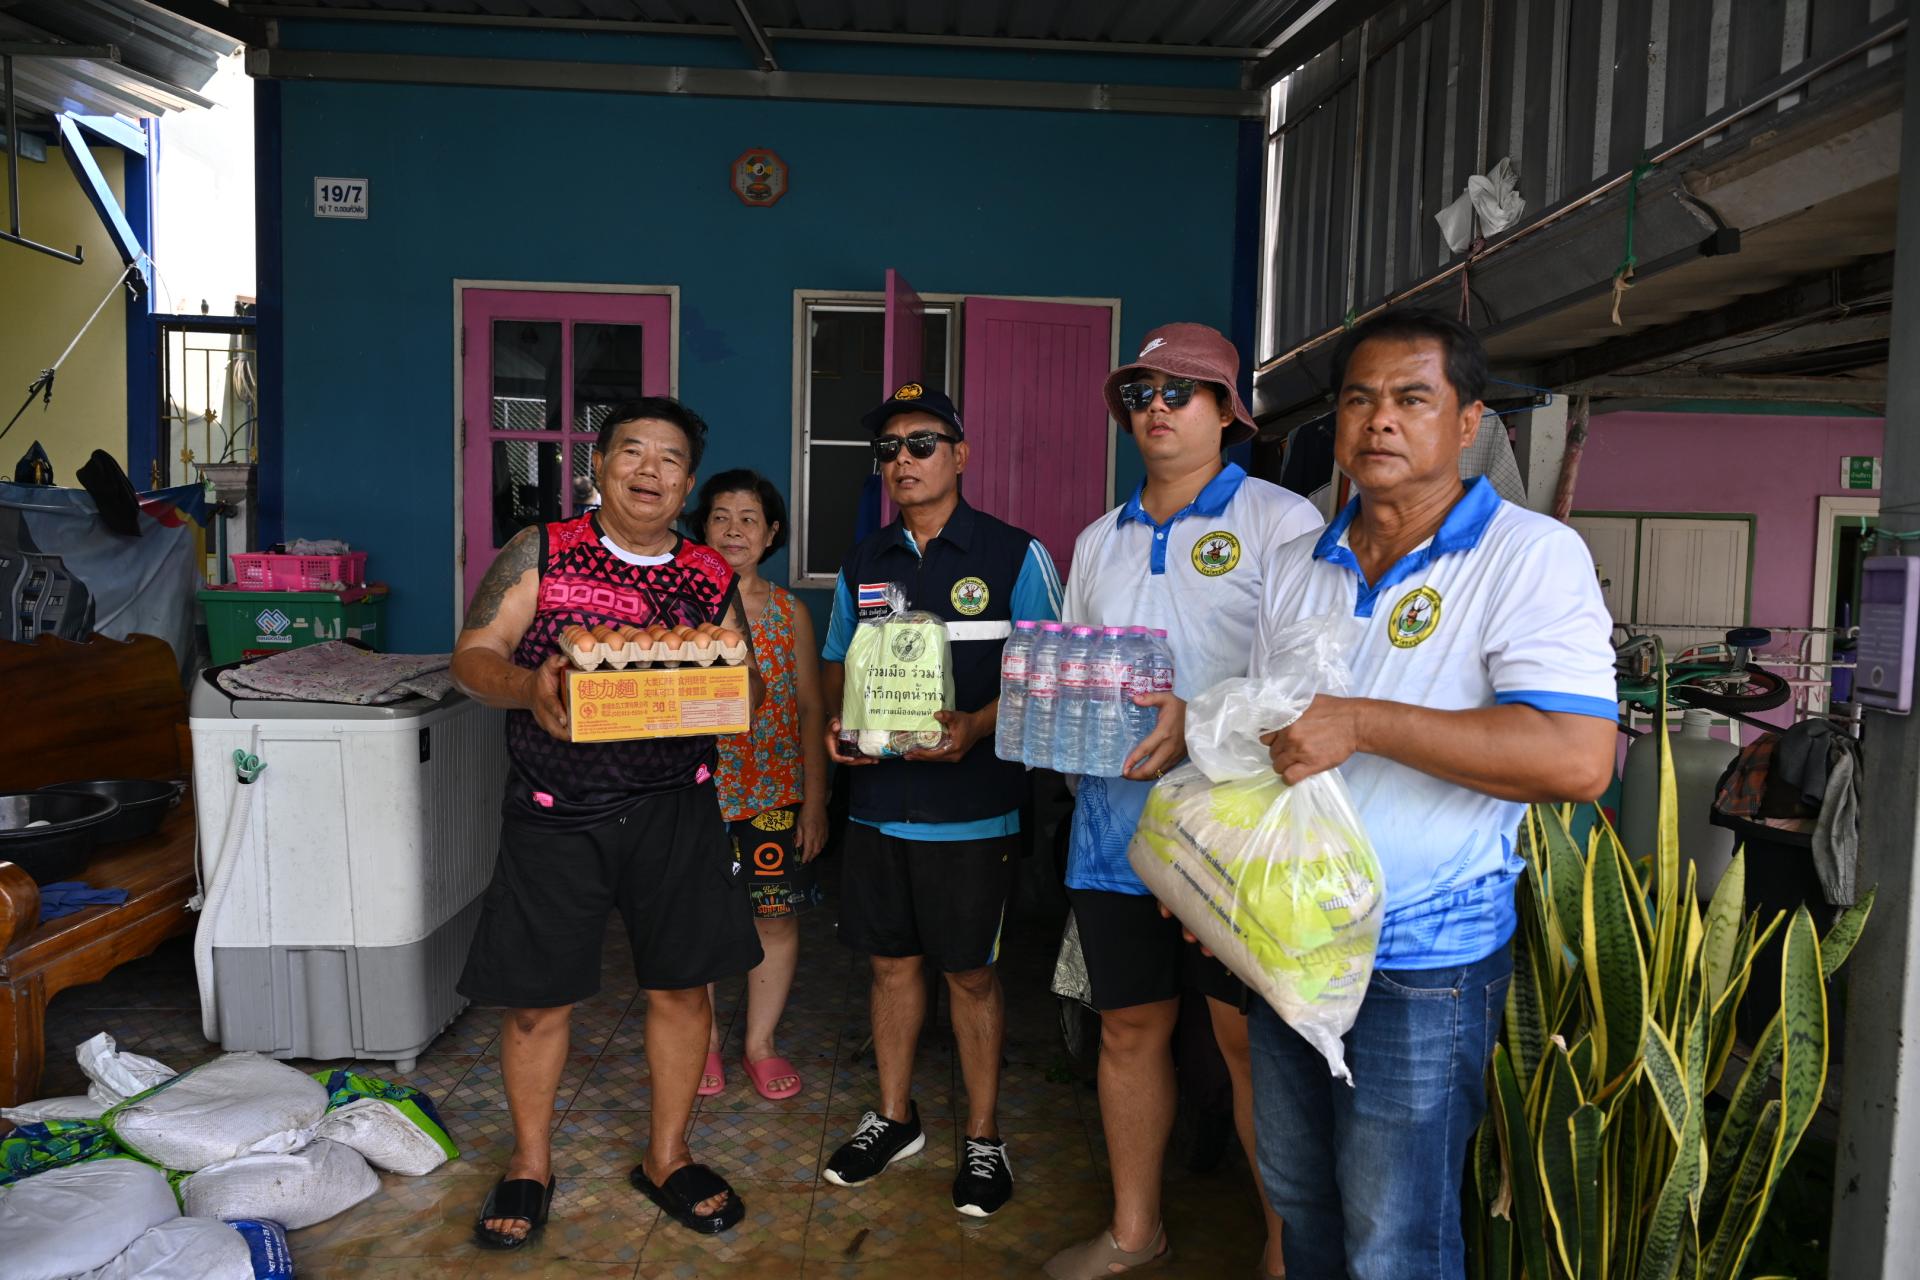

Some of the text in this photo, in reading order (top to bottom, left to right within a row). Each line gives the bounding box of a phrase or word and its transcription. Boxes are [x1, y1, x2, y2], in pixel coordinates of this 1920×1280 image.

[321, 185, 362, 203] 19/7
[866, 664, 906, 678] ร่วมมือ
[577, 679, 638, 699] 健力麵
